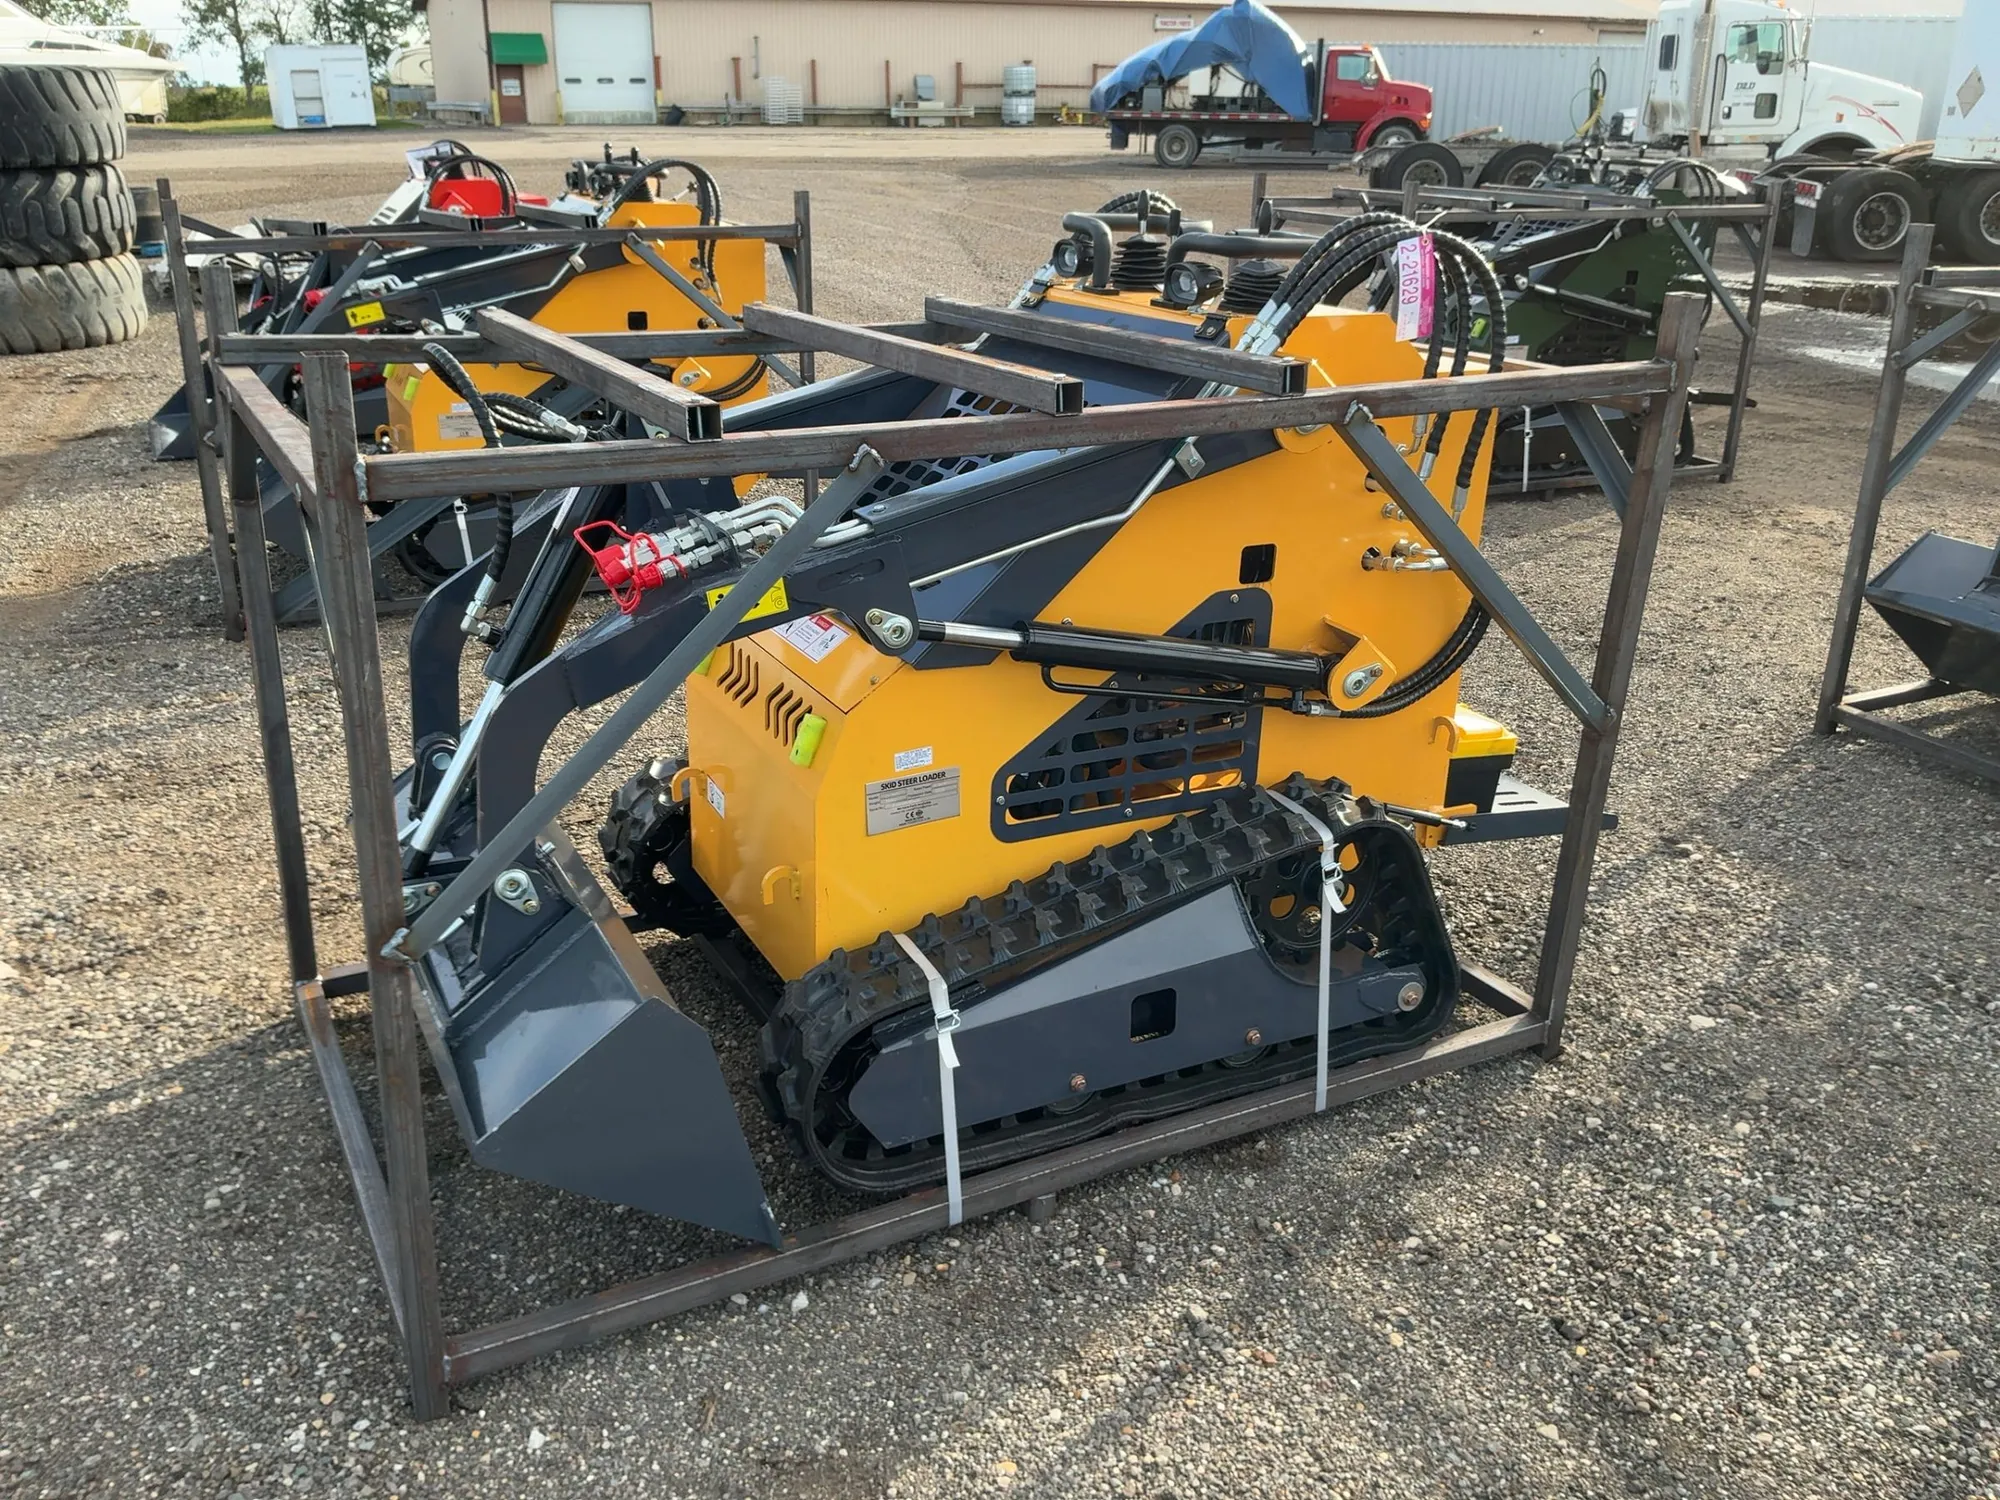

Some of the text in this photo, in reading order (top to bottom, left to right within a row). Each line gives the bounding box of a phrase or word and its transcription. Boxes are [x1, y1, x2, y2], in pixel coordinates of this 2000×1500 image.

[1400, 244, 1419, 305] 2-21629
[880, 771, 946, 790] SKID STEER LOADER
